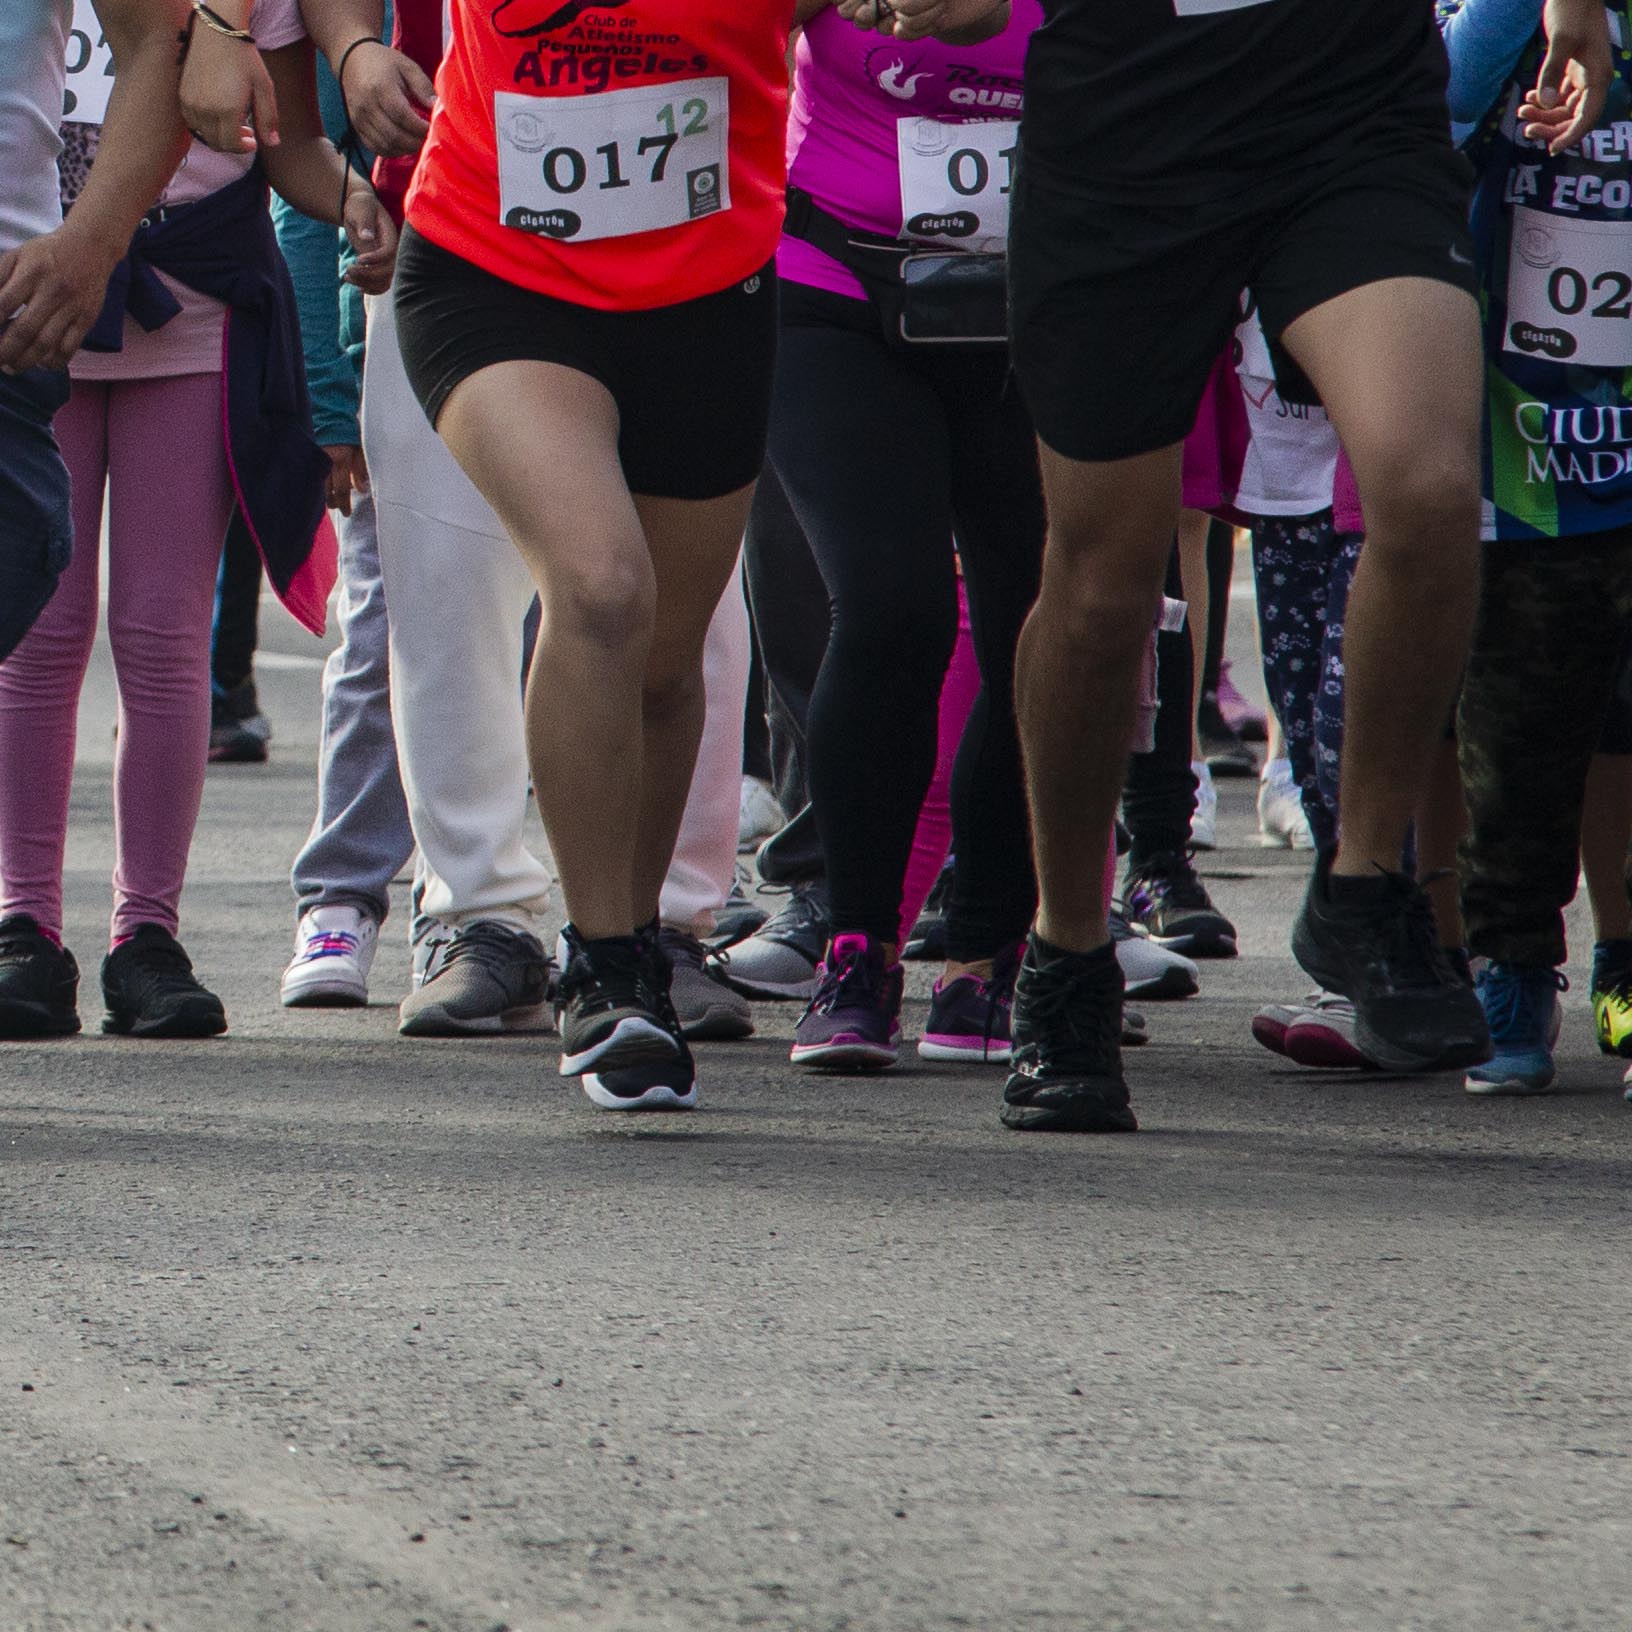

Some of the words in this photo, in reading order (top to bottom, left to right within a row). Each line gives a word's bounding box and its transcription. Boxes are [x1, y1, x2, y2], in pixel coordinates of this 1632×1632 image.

[568, 26, 681, 45] Atletismo
[583, 14, 617, 28] Club
[620, 16, 637, 28] de
[513, 51, 710, 94] Angeles
[656, 98, 709, 137] 12
[948, 87, 1024, 110] QUE
[542, 133, 678, 194] 017
[1504, 164, 1543, 204] LA
[1552, 174, 1632, 212] ECO
[1524, 446, 1632, 484] MAD
